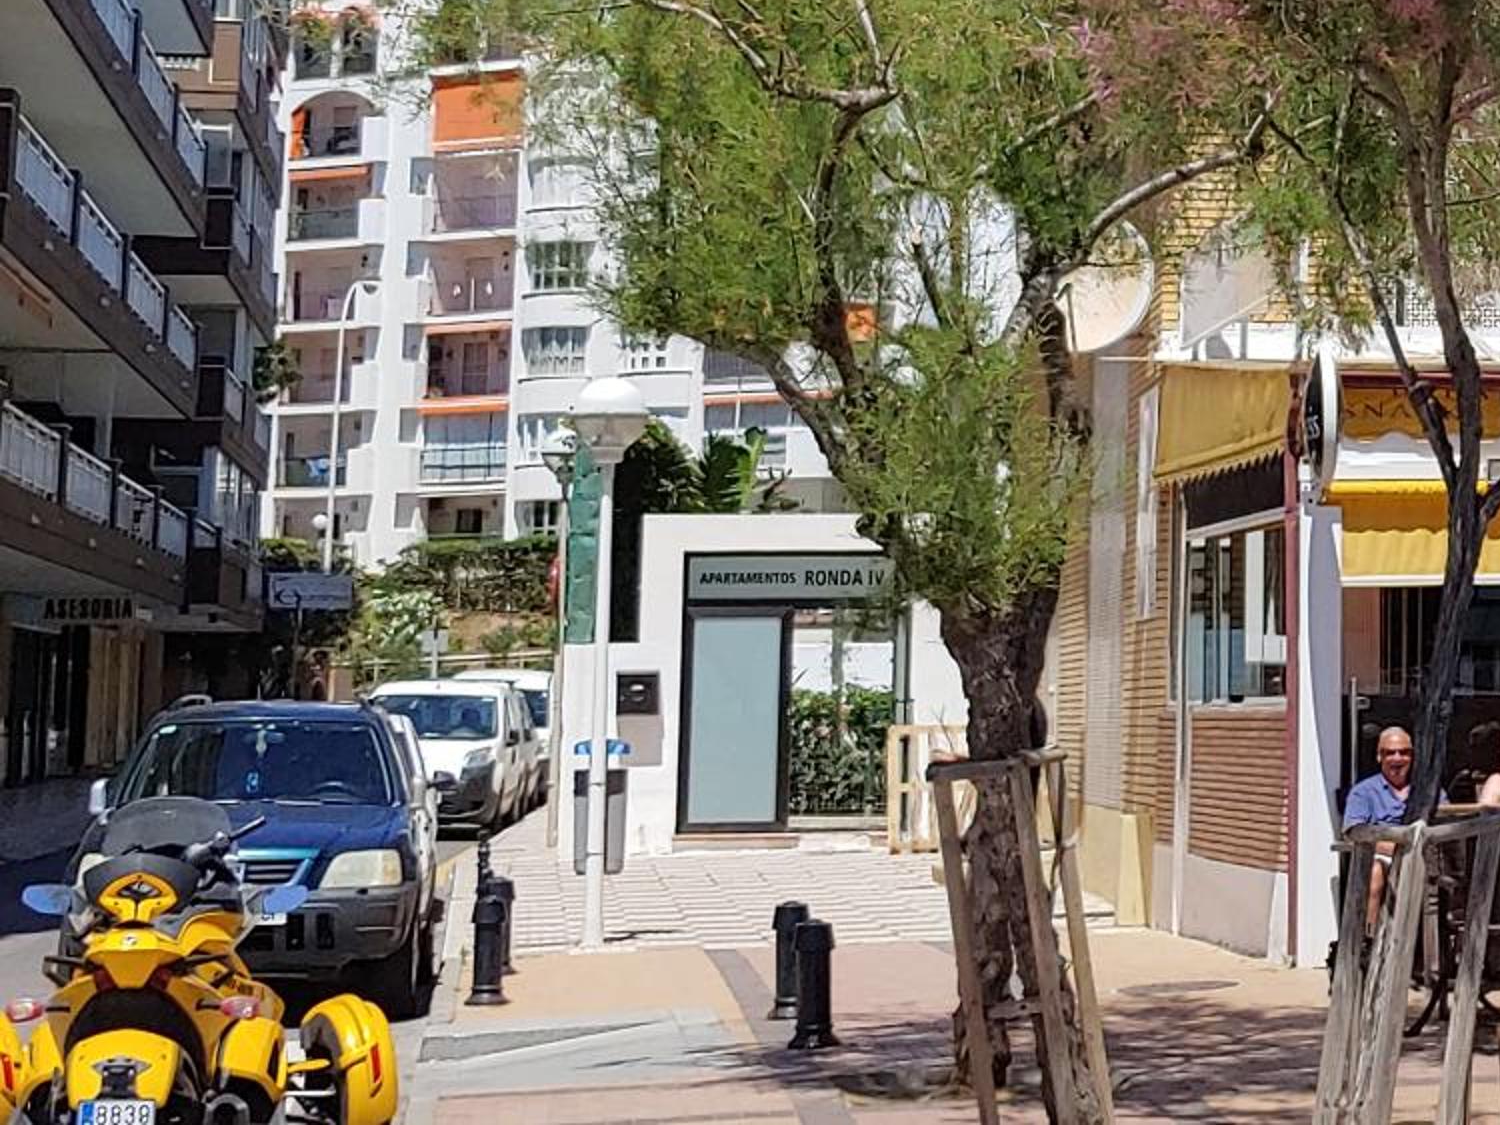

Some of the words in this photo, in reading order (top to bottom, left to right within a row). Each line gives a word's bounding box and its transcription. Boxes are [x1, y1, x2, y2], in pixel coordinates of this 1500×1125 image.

[700, 572, 797, 585] APARTAMENTOS
[804, 570, 864, 586] RONDA
[43, 597, 134, 620] ASESORIA
